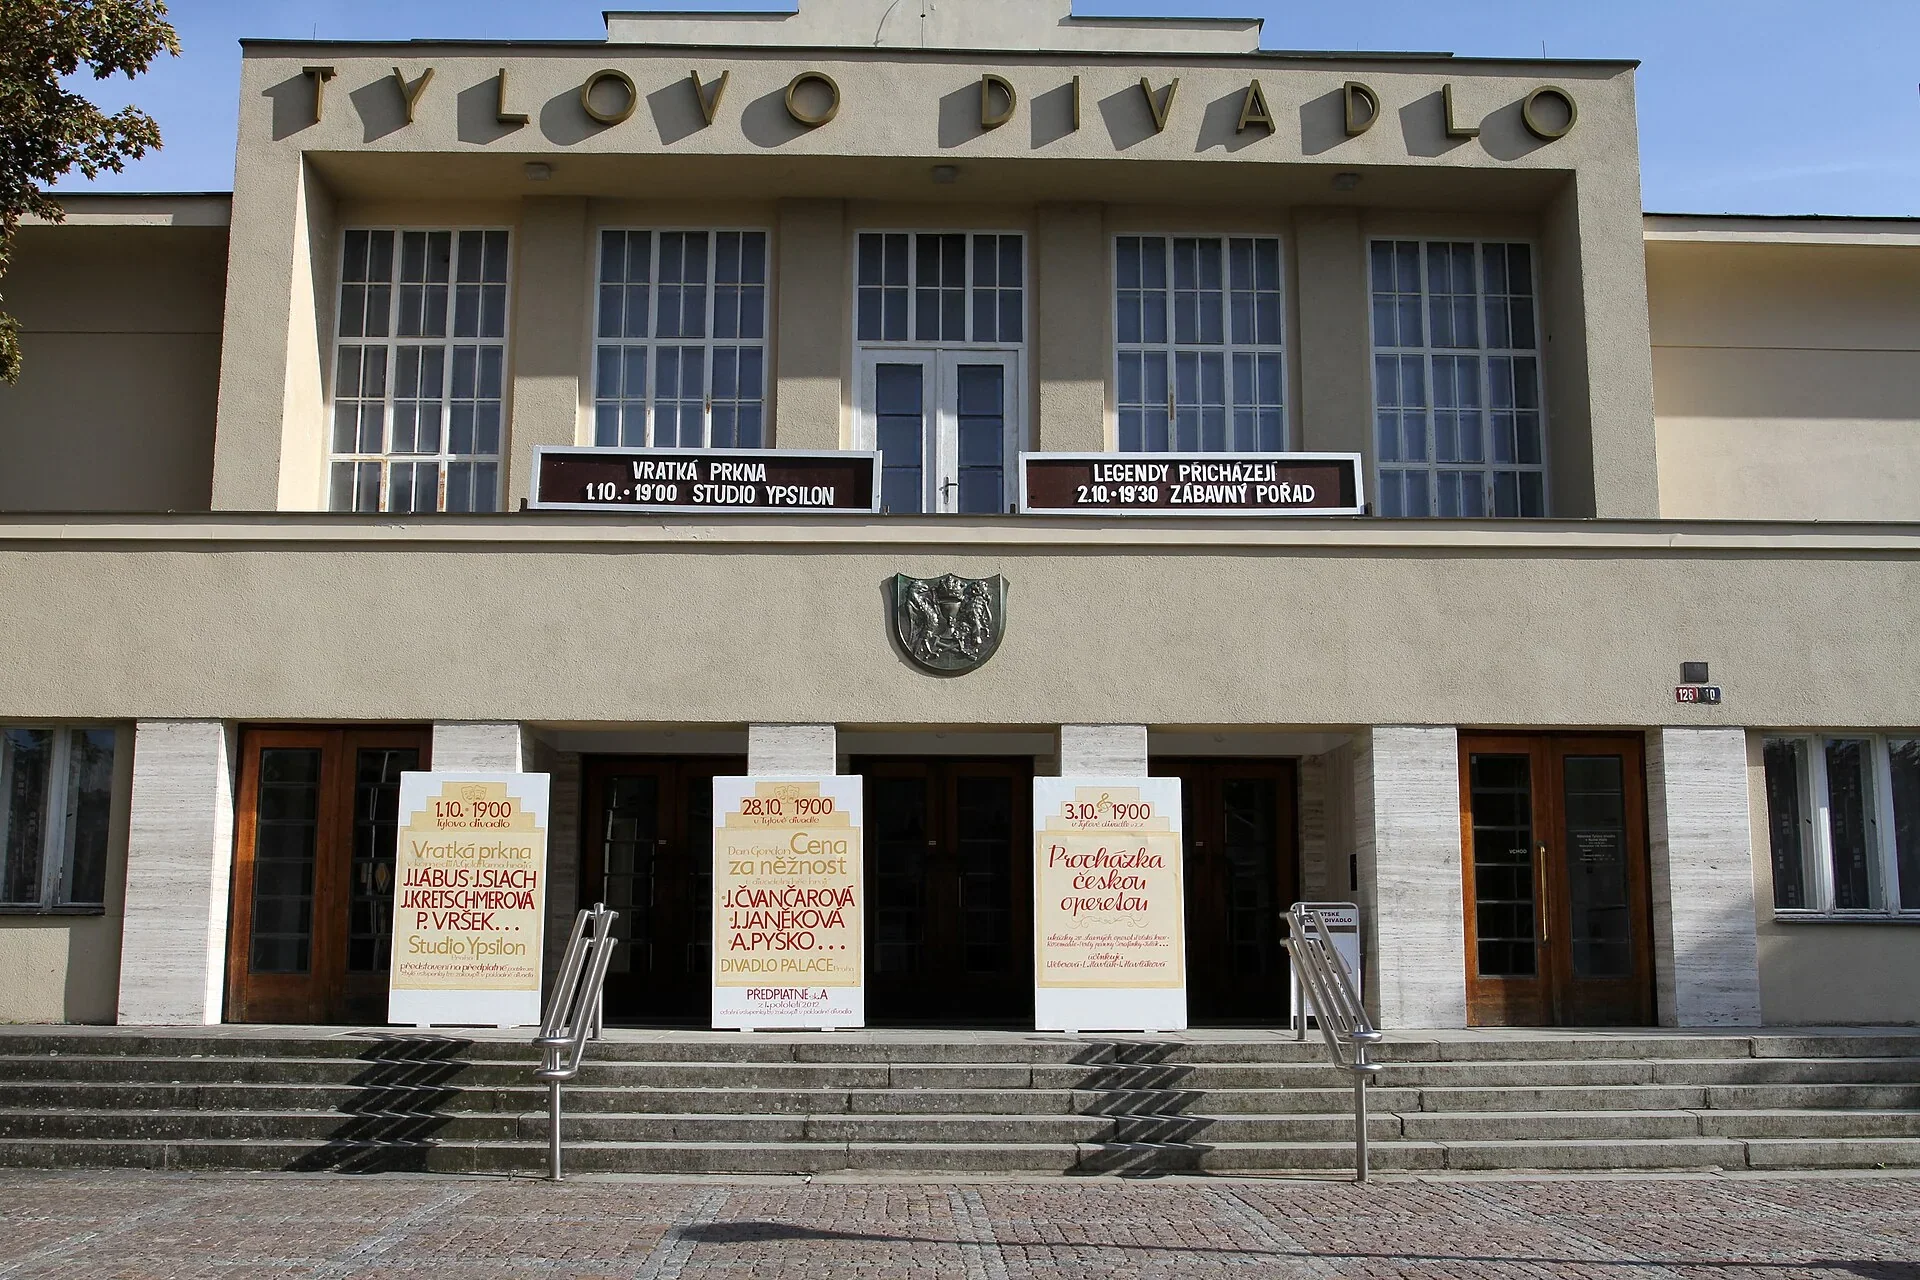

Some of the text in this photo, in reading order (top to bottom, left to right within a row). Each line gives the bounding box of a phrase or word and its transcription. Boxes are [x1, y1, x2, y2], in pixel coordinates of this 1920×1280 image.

[302, 66, 1578, 140] TYLOVO DIVADLO
[632, 459, 767, 483] VRATKÁ PRKNA
[1093, 461, 1278, 483] LEGENDY PŘICHÁZEJÍ
[692, 485, 756, 504] STUDIO
[766, 486, 835, 506] YPSILON
[1170, 481, 1248, 504] ZÁBAVNÝ
[1256, 481, 1316, 504] POŘAD
[742, 798, 833, 816] 28.10. 19'00
[1065, 803, 1151, 820] 3.10. 19'00
[437, 818, 511, 831] Tylovo divadlo
[411, 840, 532, 865] Vratká prkna
[728, 832, 848, 858] Dan Gordon Cena
[728, 856, 847, 875] za něžnost
[1048, 844, 1166, 869] Procházka
[1072, 869, 1146, 890] českou
[1060, 891, 1148, 917] operetou
[408, 935, 526, 960] Studio Ypsilon
[720, 959, 778, 973] DIVADLO
[780, 958, 834, 972] PALACE
